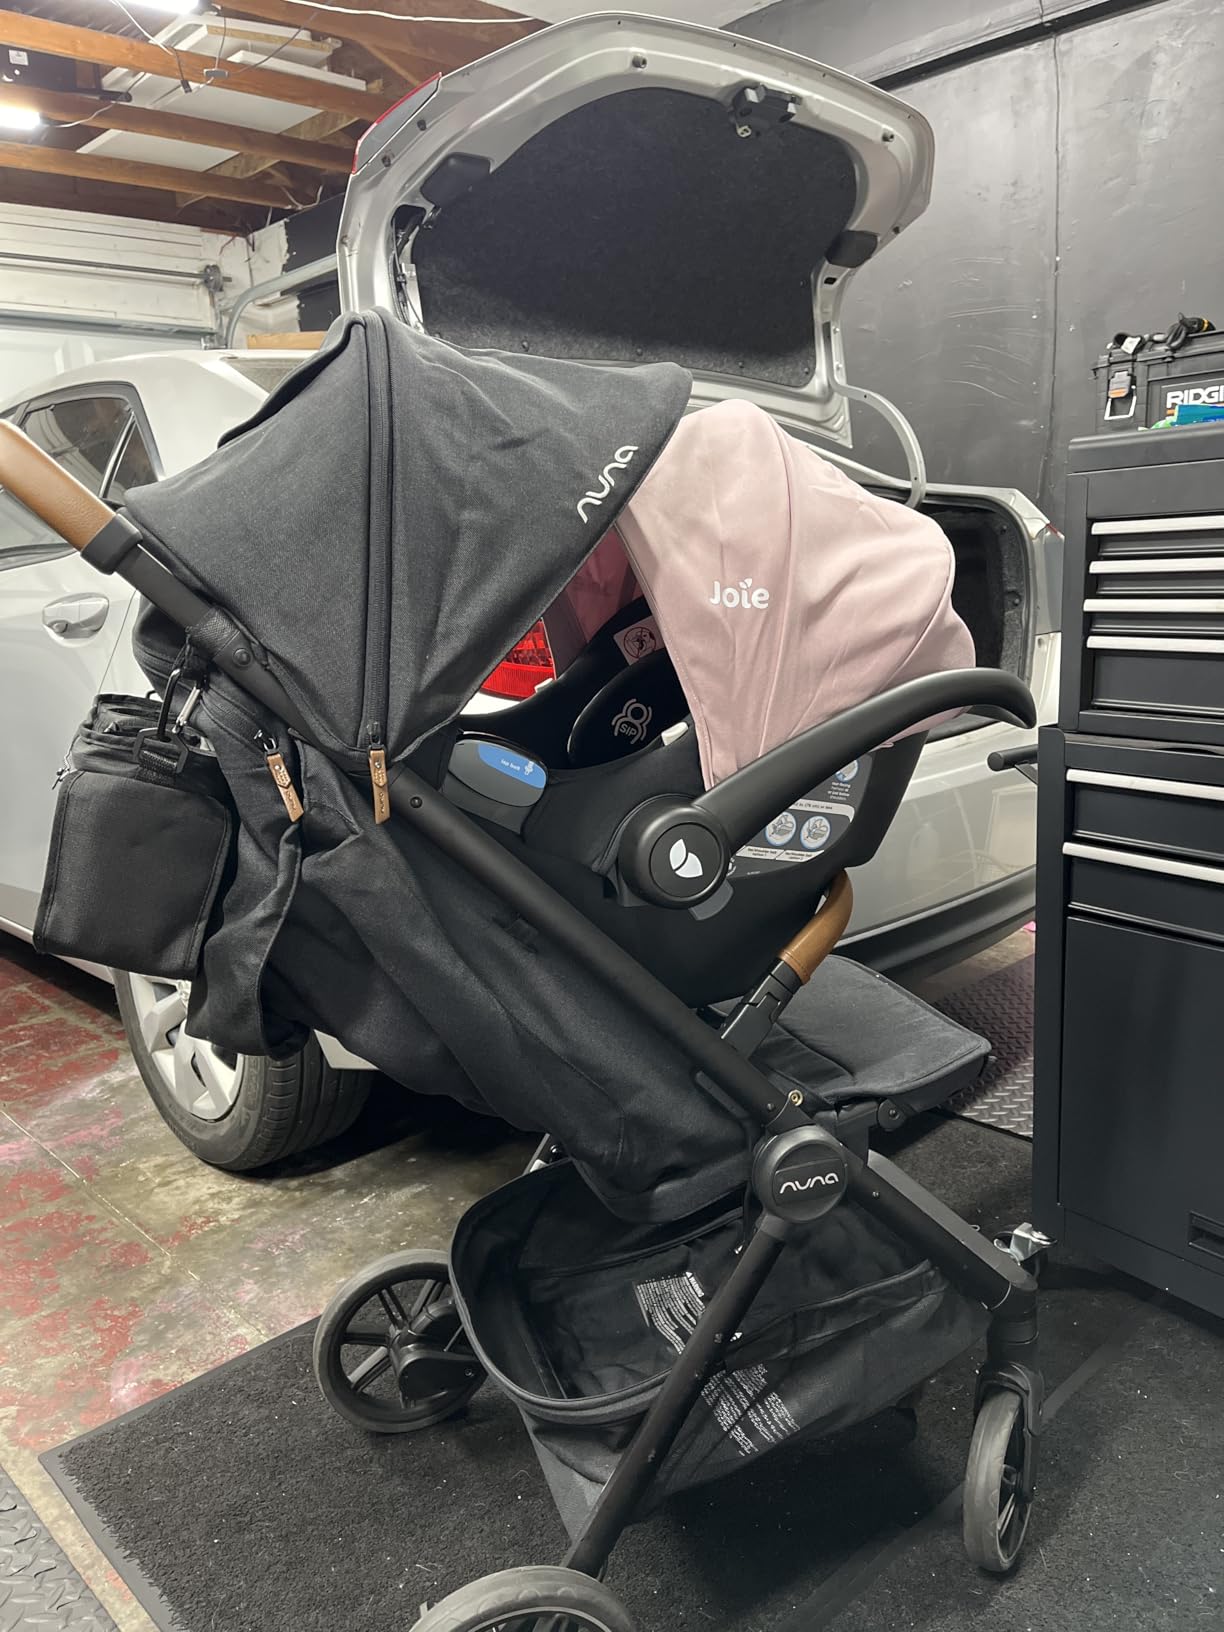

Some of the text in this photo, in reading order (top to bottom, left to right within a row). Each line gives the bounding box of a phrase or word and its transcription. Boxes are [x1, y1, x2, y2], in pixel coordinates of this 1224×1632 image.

[576, 445, 639, 524] nuna
[709, 577, 770, 609] Joie
[619, 723, 637, 737] SIP
[779, 1172, 840, 1194] nuna
